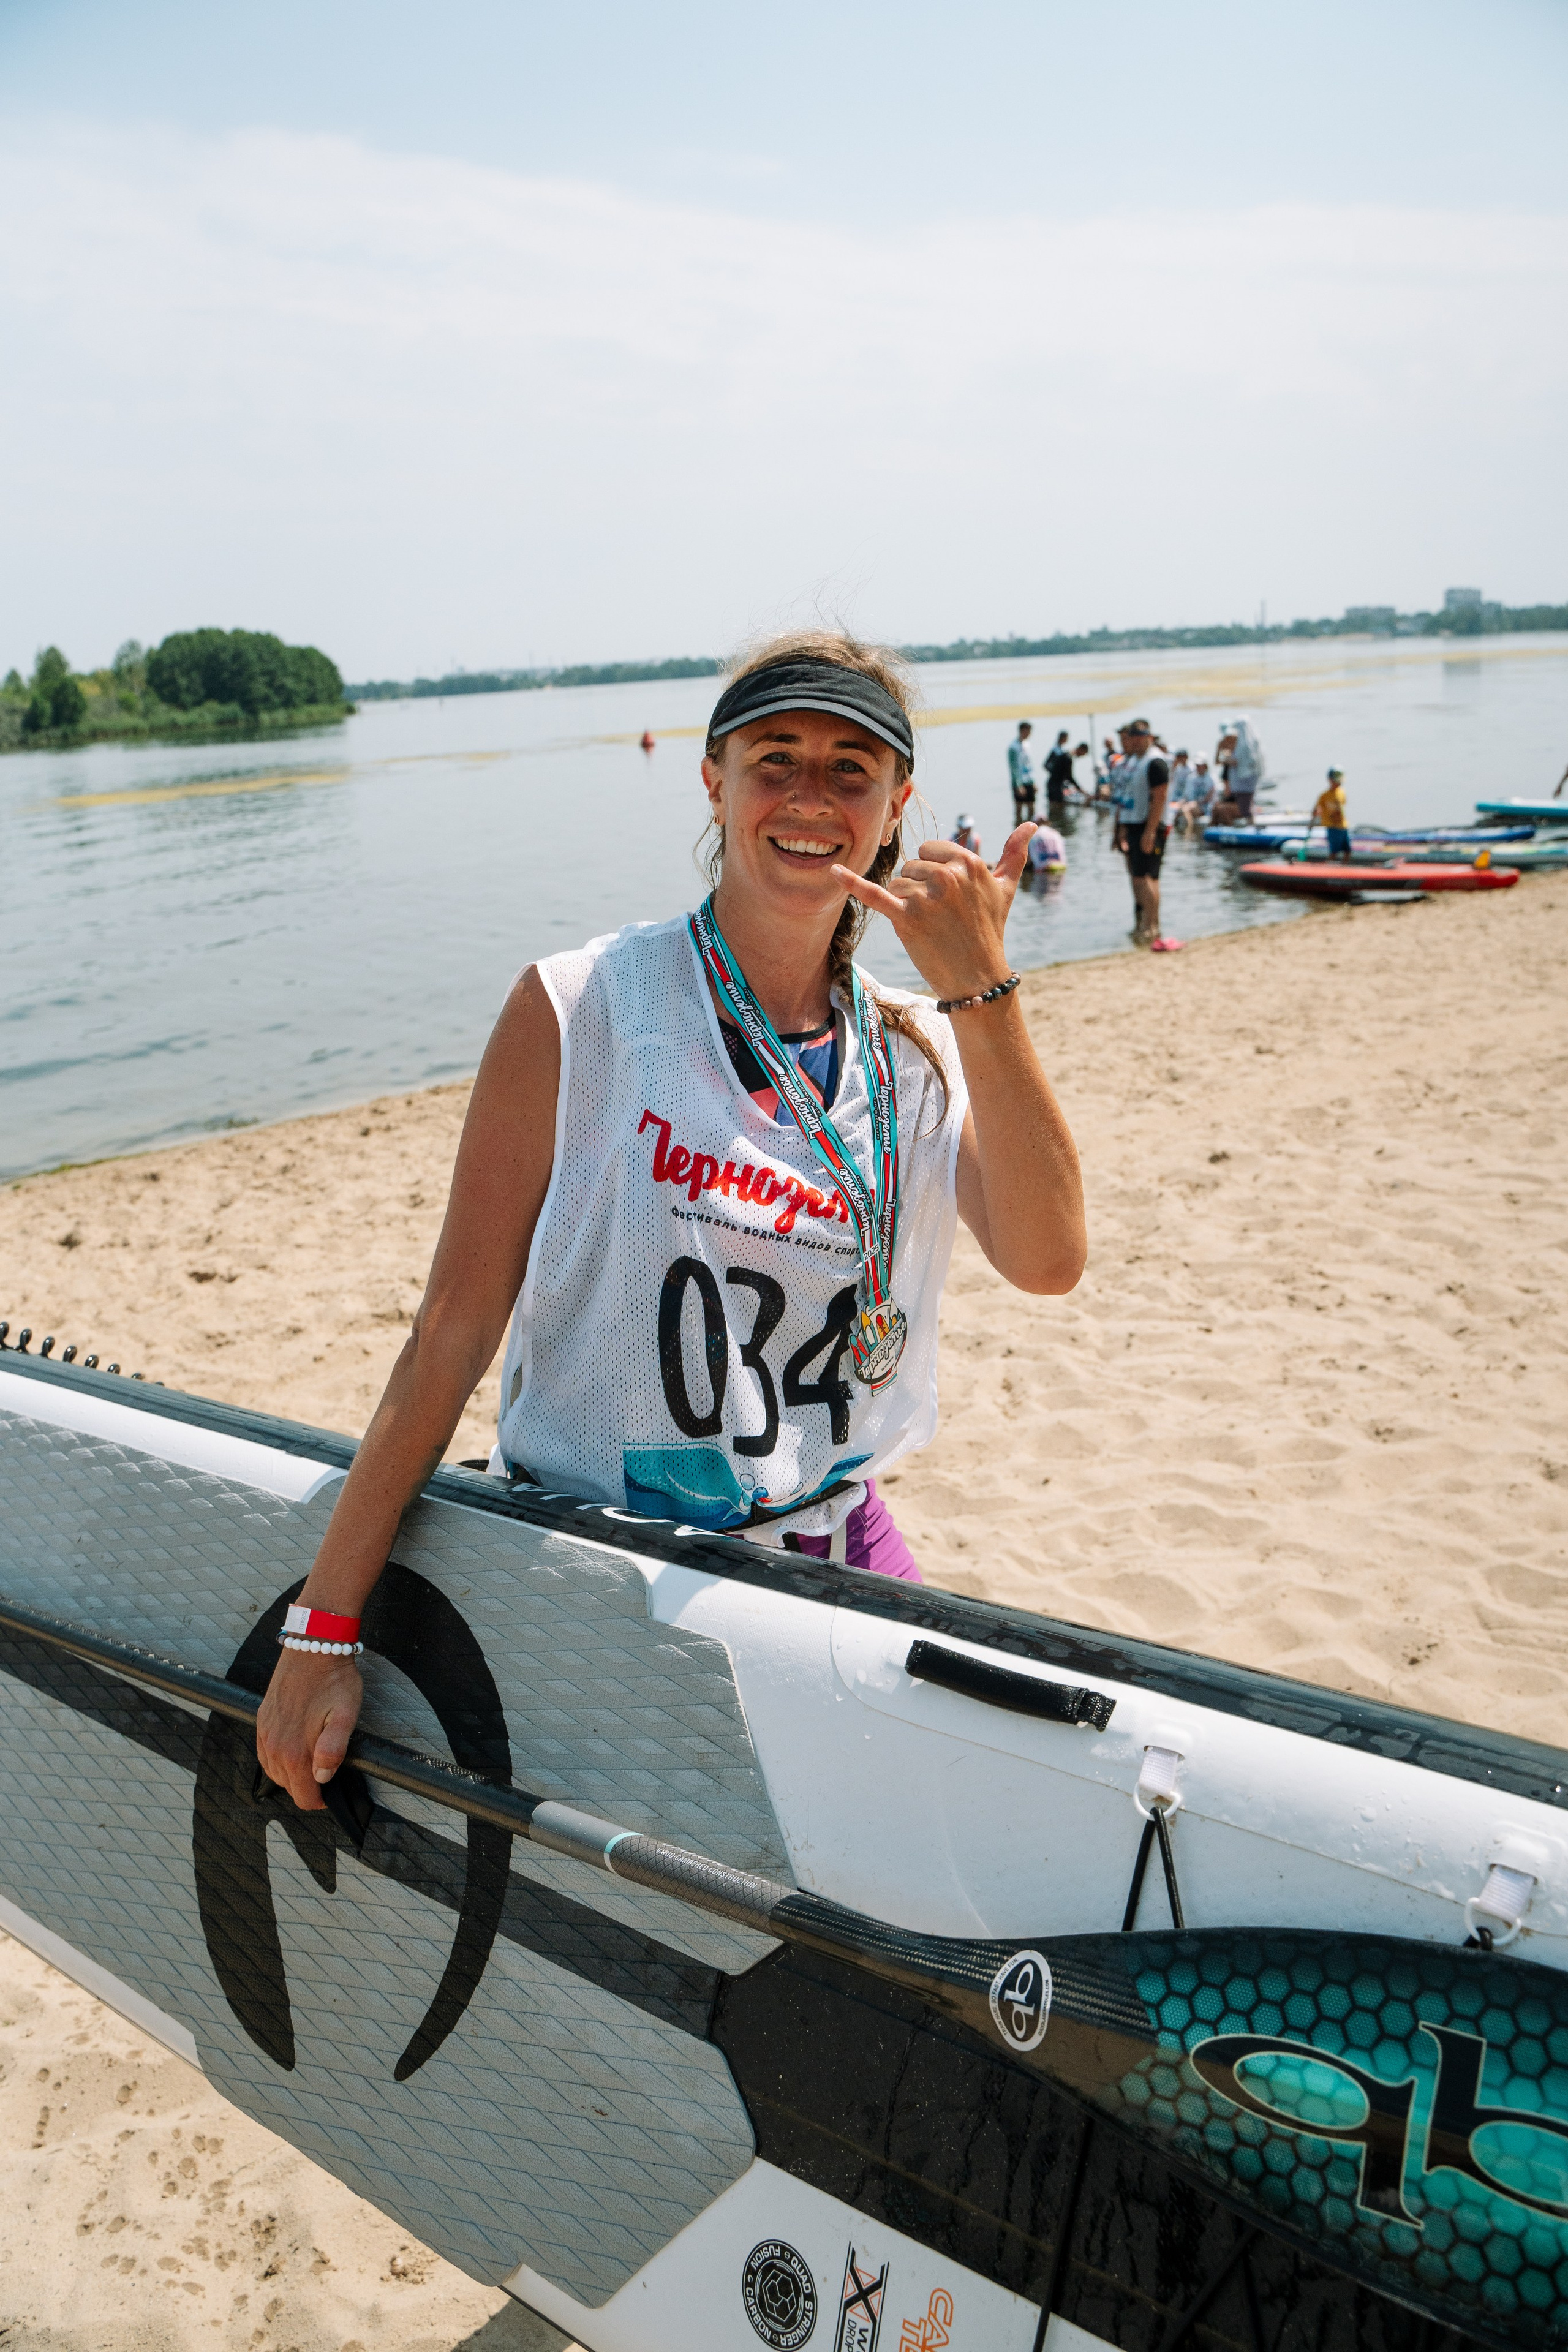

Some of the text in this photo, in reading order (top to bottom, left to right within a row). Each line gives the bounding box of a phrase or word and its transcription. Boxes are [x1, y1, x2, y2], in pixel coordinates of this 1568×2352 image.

[694, 907, 714, 956] Чернозем
[863, 989, 882, 1049] ерноземье
[671, 1206, 738, 1231] фестиваль
[743, 1226, 791, 1243] водных
[794, 1237, 831, 1251] видов
[863, 1244, 880, 1261] 2025
[658, 1255, 858, 1457] 034
[299, 1610, 307, 1630] 926418
[655, 1847, 709, 1872] VARIO-CAMBERED
[707, 1867, 758, 1889] CONSTRUCTION
[998, 1968, 1009, 1981] HAVE
[991, 1996, 997, 2004] GO
[997, 2021, 1008, 2036] TRAIN
[745, 2245, 781, 2340] CARBON FUSION
[780, 2256, 813, 2346] QUAD STRINGER
